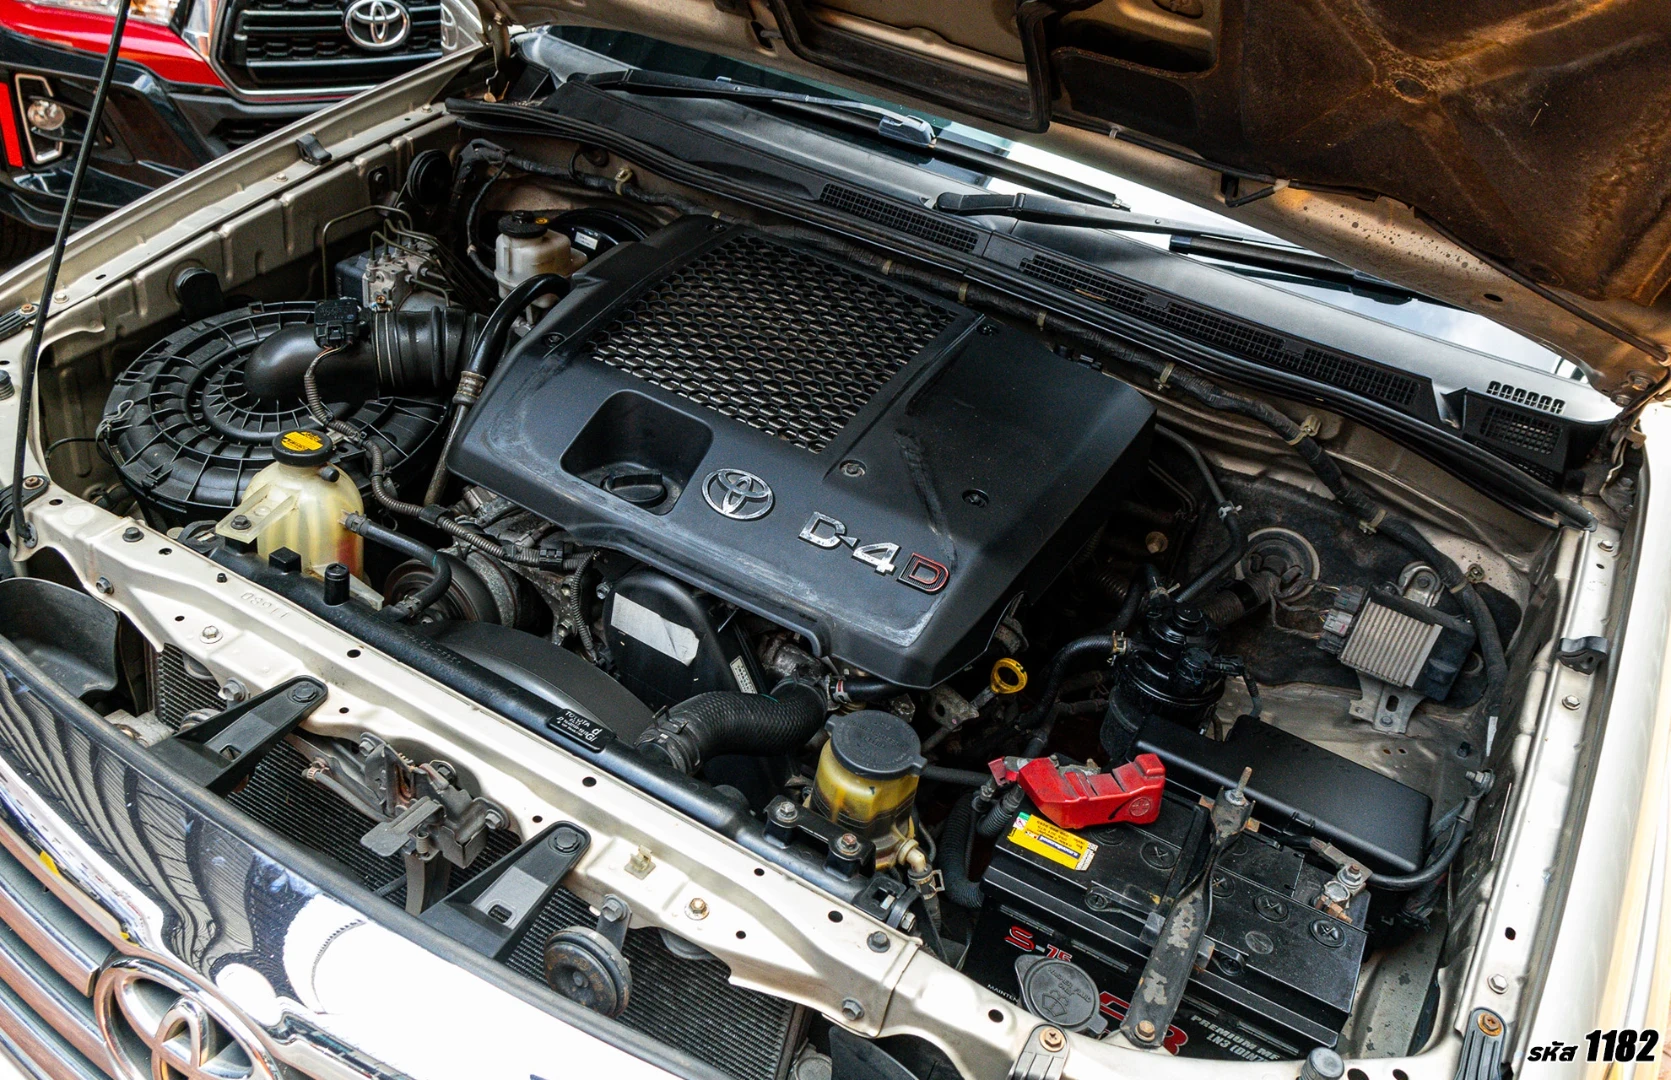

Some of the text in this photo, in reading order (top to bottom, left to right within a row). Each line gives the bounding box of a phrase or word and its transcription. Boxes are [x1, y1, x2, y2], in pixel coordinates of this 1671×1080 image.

[565, 711, 591, 727] TOYOTA
[1190, 1014, 1280, 1060] PREMIUM MF
[1206, 1033, 1231, 1048] LN3
